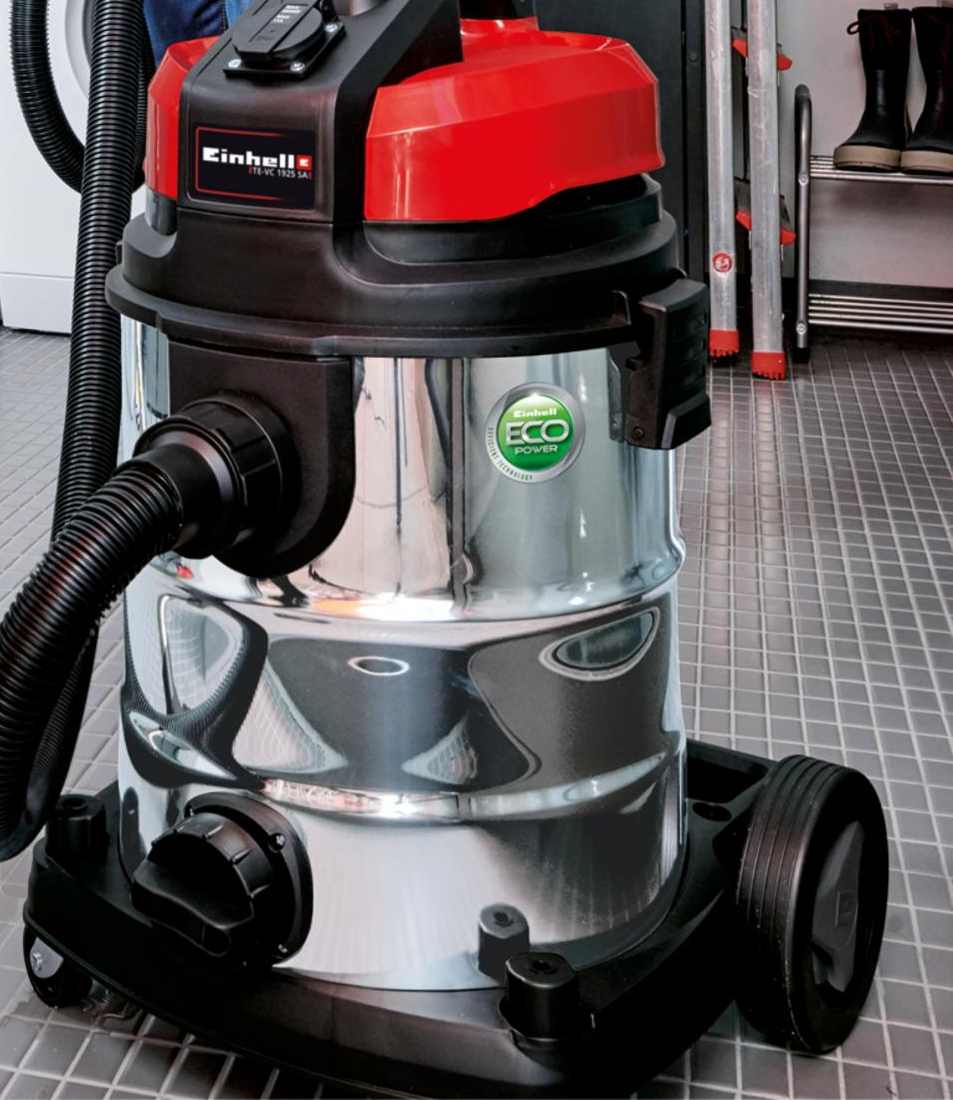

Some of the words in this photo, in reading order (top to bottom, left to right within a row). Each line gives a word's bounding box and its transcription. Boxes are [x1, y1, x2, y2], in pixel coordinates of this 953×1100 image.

[202, 146, 295, 169] Einhell
[253, 166, 275, 177] TE-VC
[277, 168, 296, 178] 1925
[297, 170, 308, 179] SA
[513, 407, 557, 418] Einhell
[505, 419, 569, 445] ECO
[515, 444, 558, 455] POWER
